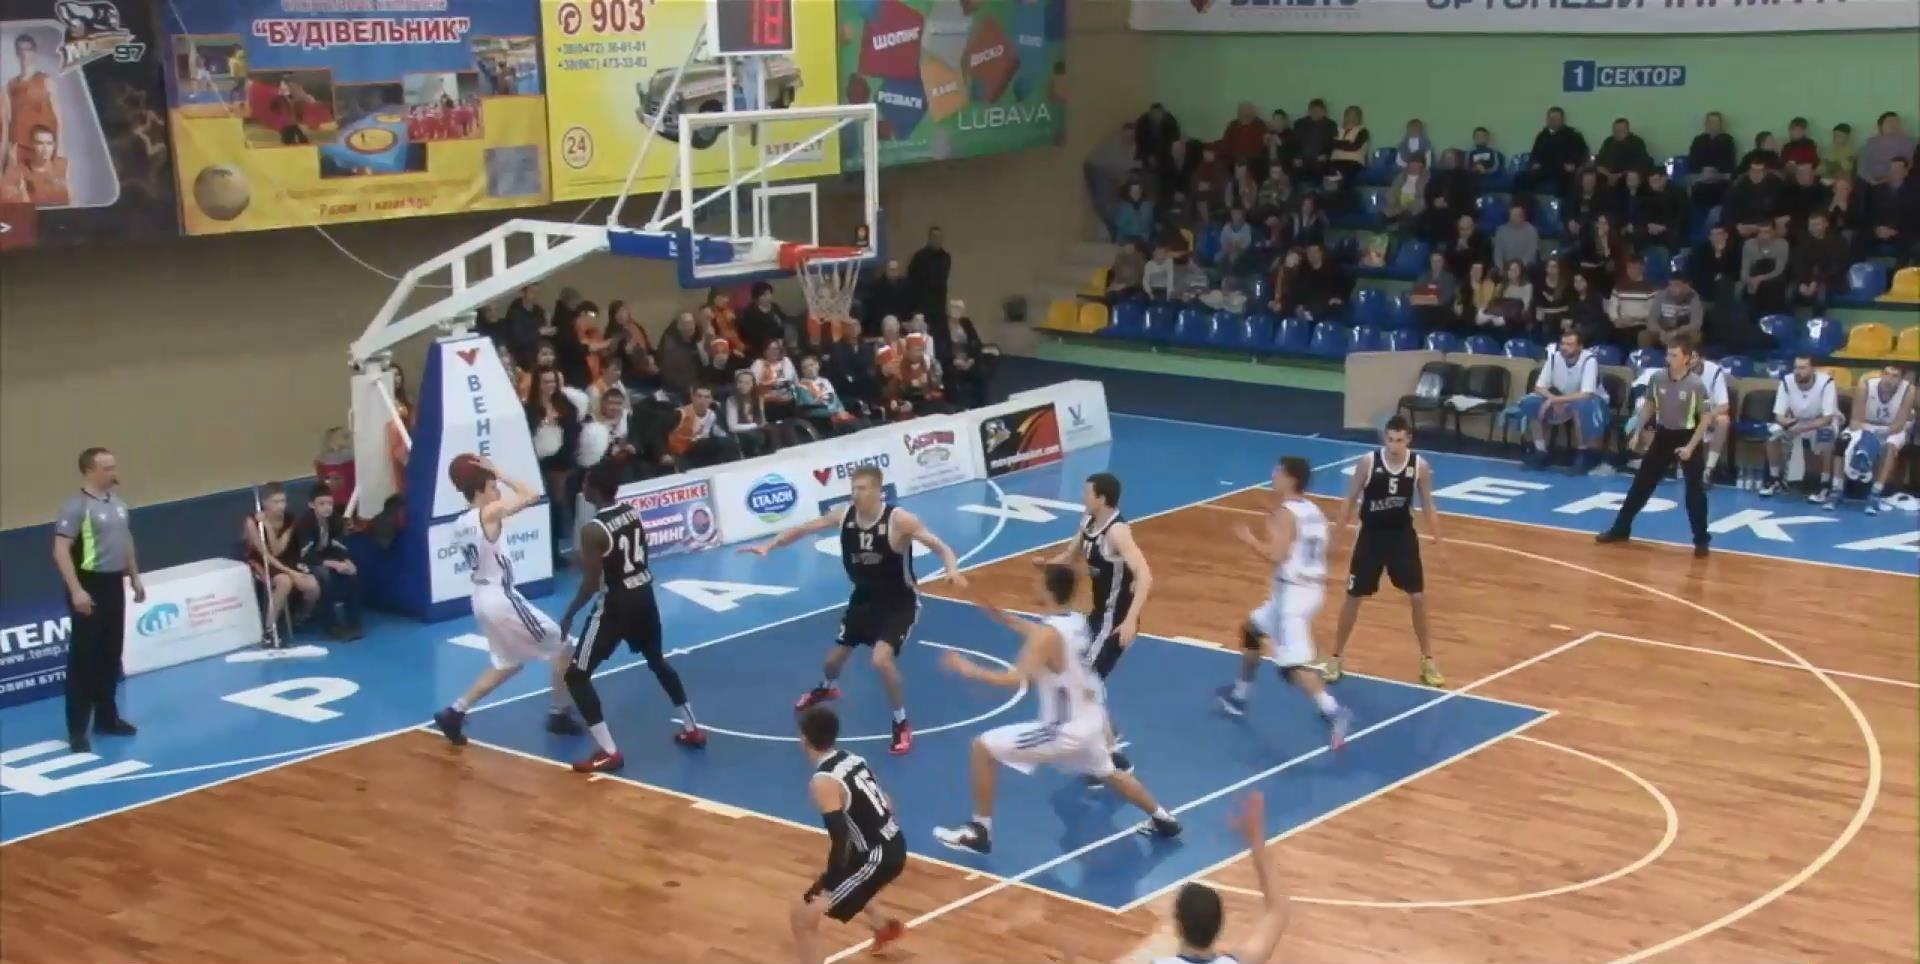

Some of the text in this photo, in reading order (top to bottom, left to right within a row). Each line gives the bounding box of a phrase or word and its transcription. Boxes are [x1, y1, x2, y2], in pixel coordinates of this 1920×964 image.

[591, 0, 645, 33] 903
[1573, 66, 1682, 87] 1 СЕКТОР
[957, 103, 1051, 130] LUBAVA
[567, 136, 587, 155] 24
[467, 374, 490, 457] ВЕНЕ
[662, 484, 709, 505] STRIKE
[1388, 477, 1399, 494] 5
[619, 527, 645, 574] 24
[858, 533, 874, 550] 12
